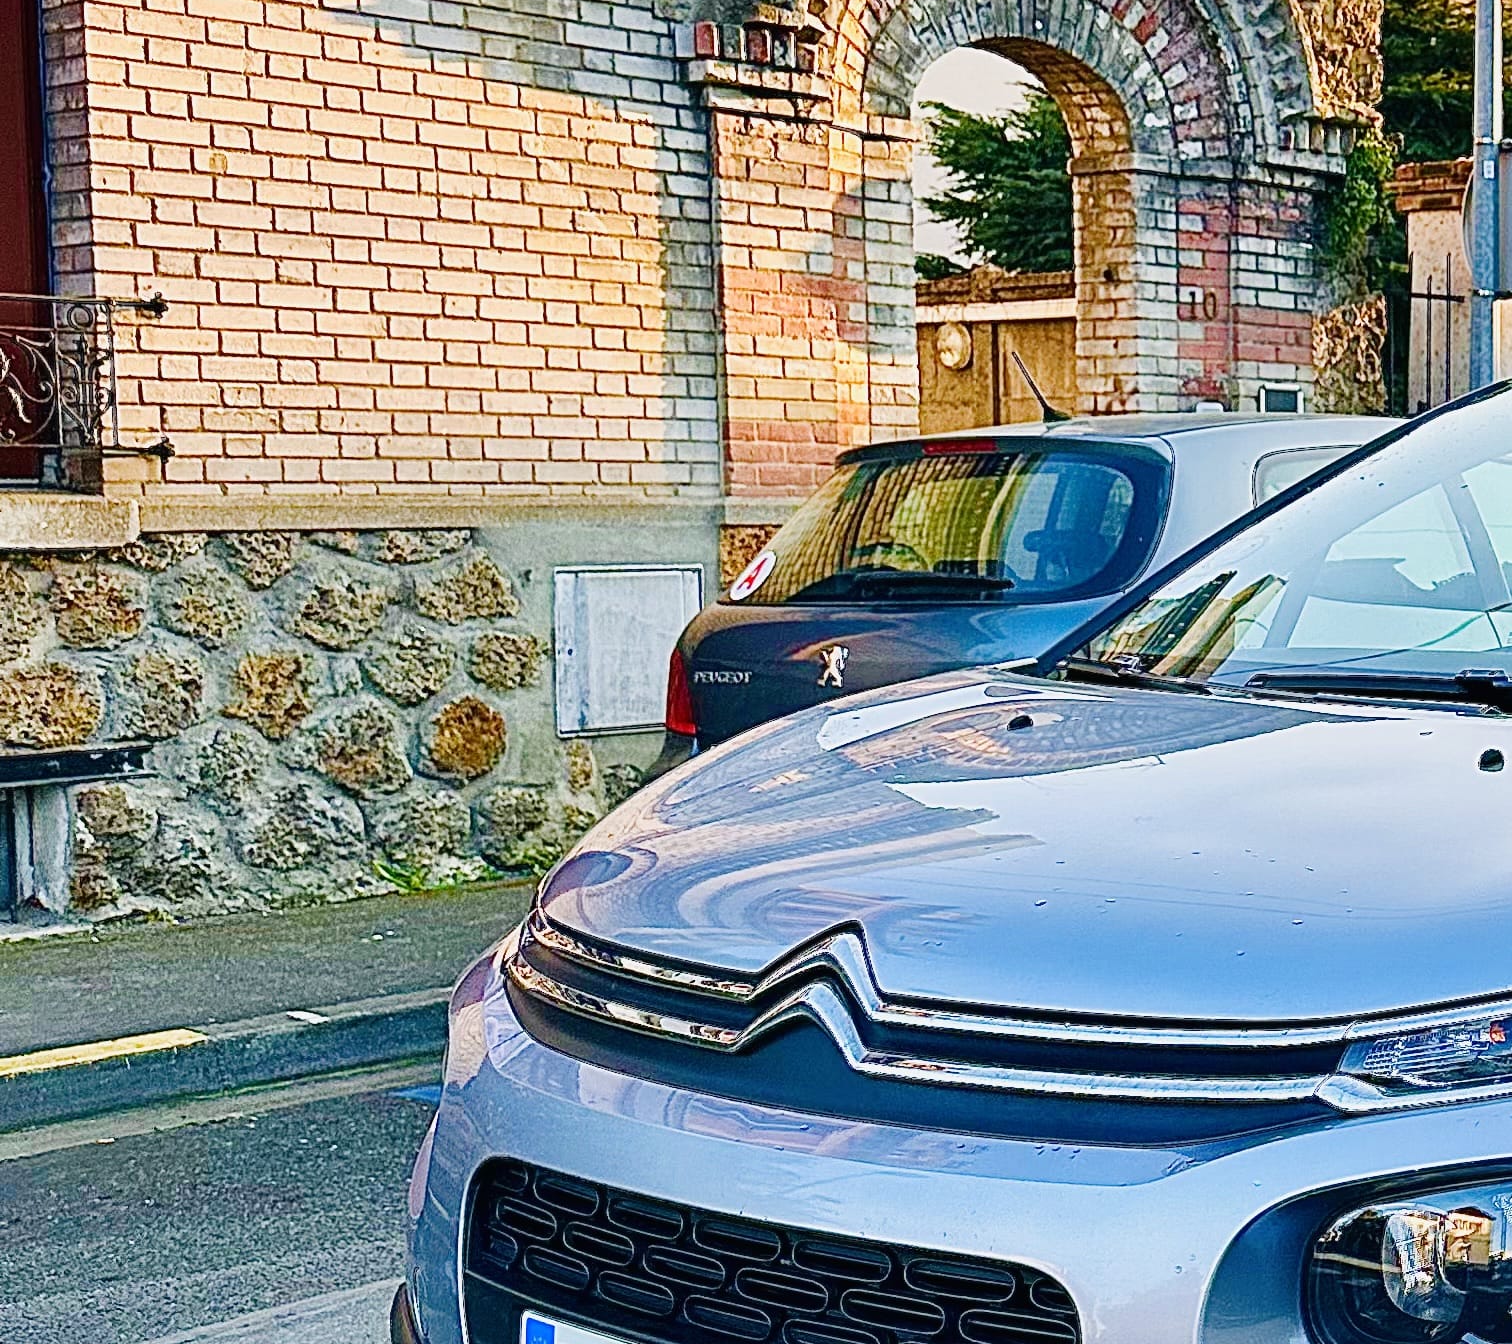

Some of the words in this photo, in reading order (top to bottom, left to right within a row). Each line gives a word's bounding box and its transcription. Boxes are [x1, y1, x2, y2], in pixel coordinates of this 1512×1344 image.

[1188, 291, 1217, 320] 10
[736, 557, 768, 590] A
[693, 671, 753, 684] PEUGEOT
